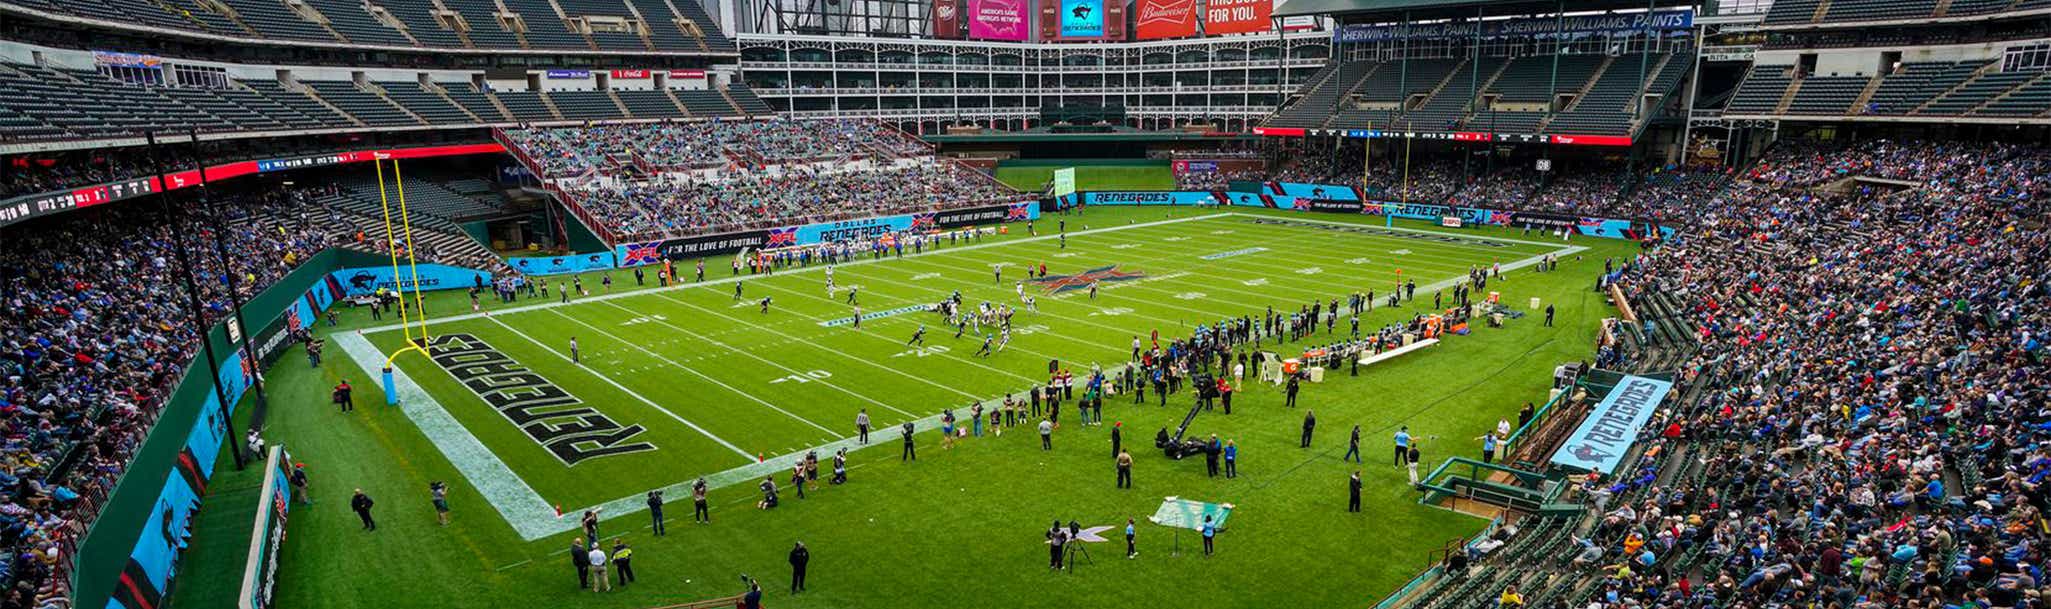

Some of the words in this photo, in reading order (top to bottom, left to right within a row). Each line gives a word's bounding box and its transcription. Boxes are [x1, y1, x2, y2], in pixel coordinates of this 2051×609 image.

[1209, 8, 1229, 23] FOR
[1232, 6, 1257, 21] YOU.
[1632, 14, 1684, 28] PAINTS
[1095, 192, 1169, 202] RENEGADES
[1395, 204, 1477, 220] RENEGAES
[684, 244, 698, 252] THE
[699, 240, 717, 250] LOVE
[718, 240, 727, 249] OF
[728, 236, 762, 248] FOOTBALL
[768, 232, 797, 244] XFL
[624, 247, 661, 261] XFL
[411, 333, 659, 467] RENEGADES
[1583, 380, 1659, 447] RENEGADES
